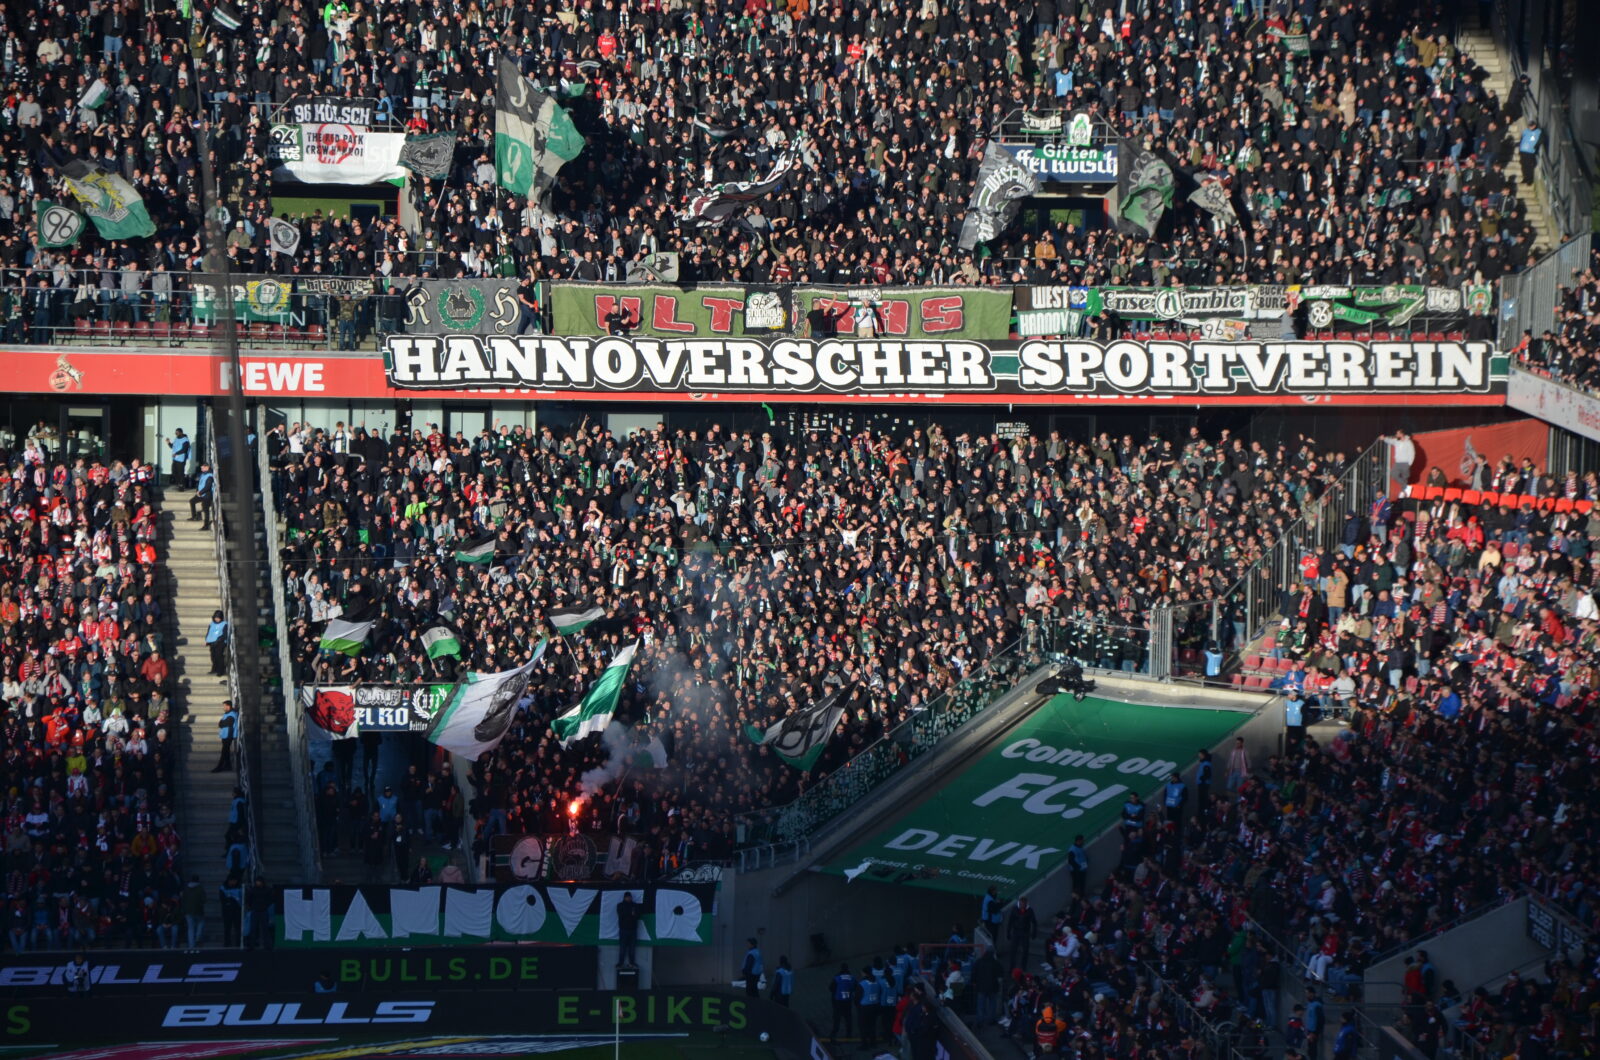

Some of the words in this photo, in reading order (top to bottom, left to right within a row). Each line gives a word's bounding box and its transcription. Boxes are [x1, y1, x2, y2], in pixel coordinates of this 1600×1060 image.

[294, 104, 312, 123] 96
[314, 99, 371, 125] KÖLSCH
[306, 132, 323, 143] THE
[1042, 143, 1098, 160] Giften
[43, 208, 75, 242] 96
[1031, 286, 1070, 309] WEST
[1019, 310, 1079, 336] HANNOVR
[1205, 320, 1225, 339] 96
[390, 338, 989, 387] HANNOVERSCHER
[1021, 342, 1487, 388] SPORTVEREIN
[219, 362, 325, 392] REWE
[1000, 737, 1115, 773] Come
[971, 772, 1129, 819] FC!
[884, 828, 1062, 870] DEVK
[340, 956, 539, 982] BULLS.DE
[161, 1001, 437, 1028] BULLS
[557, 996, 747, 1029] E-BIKES
